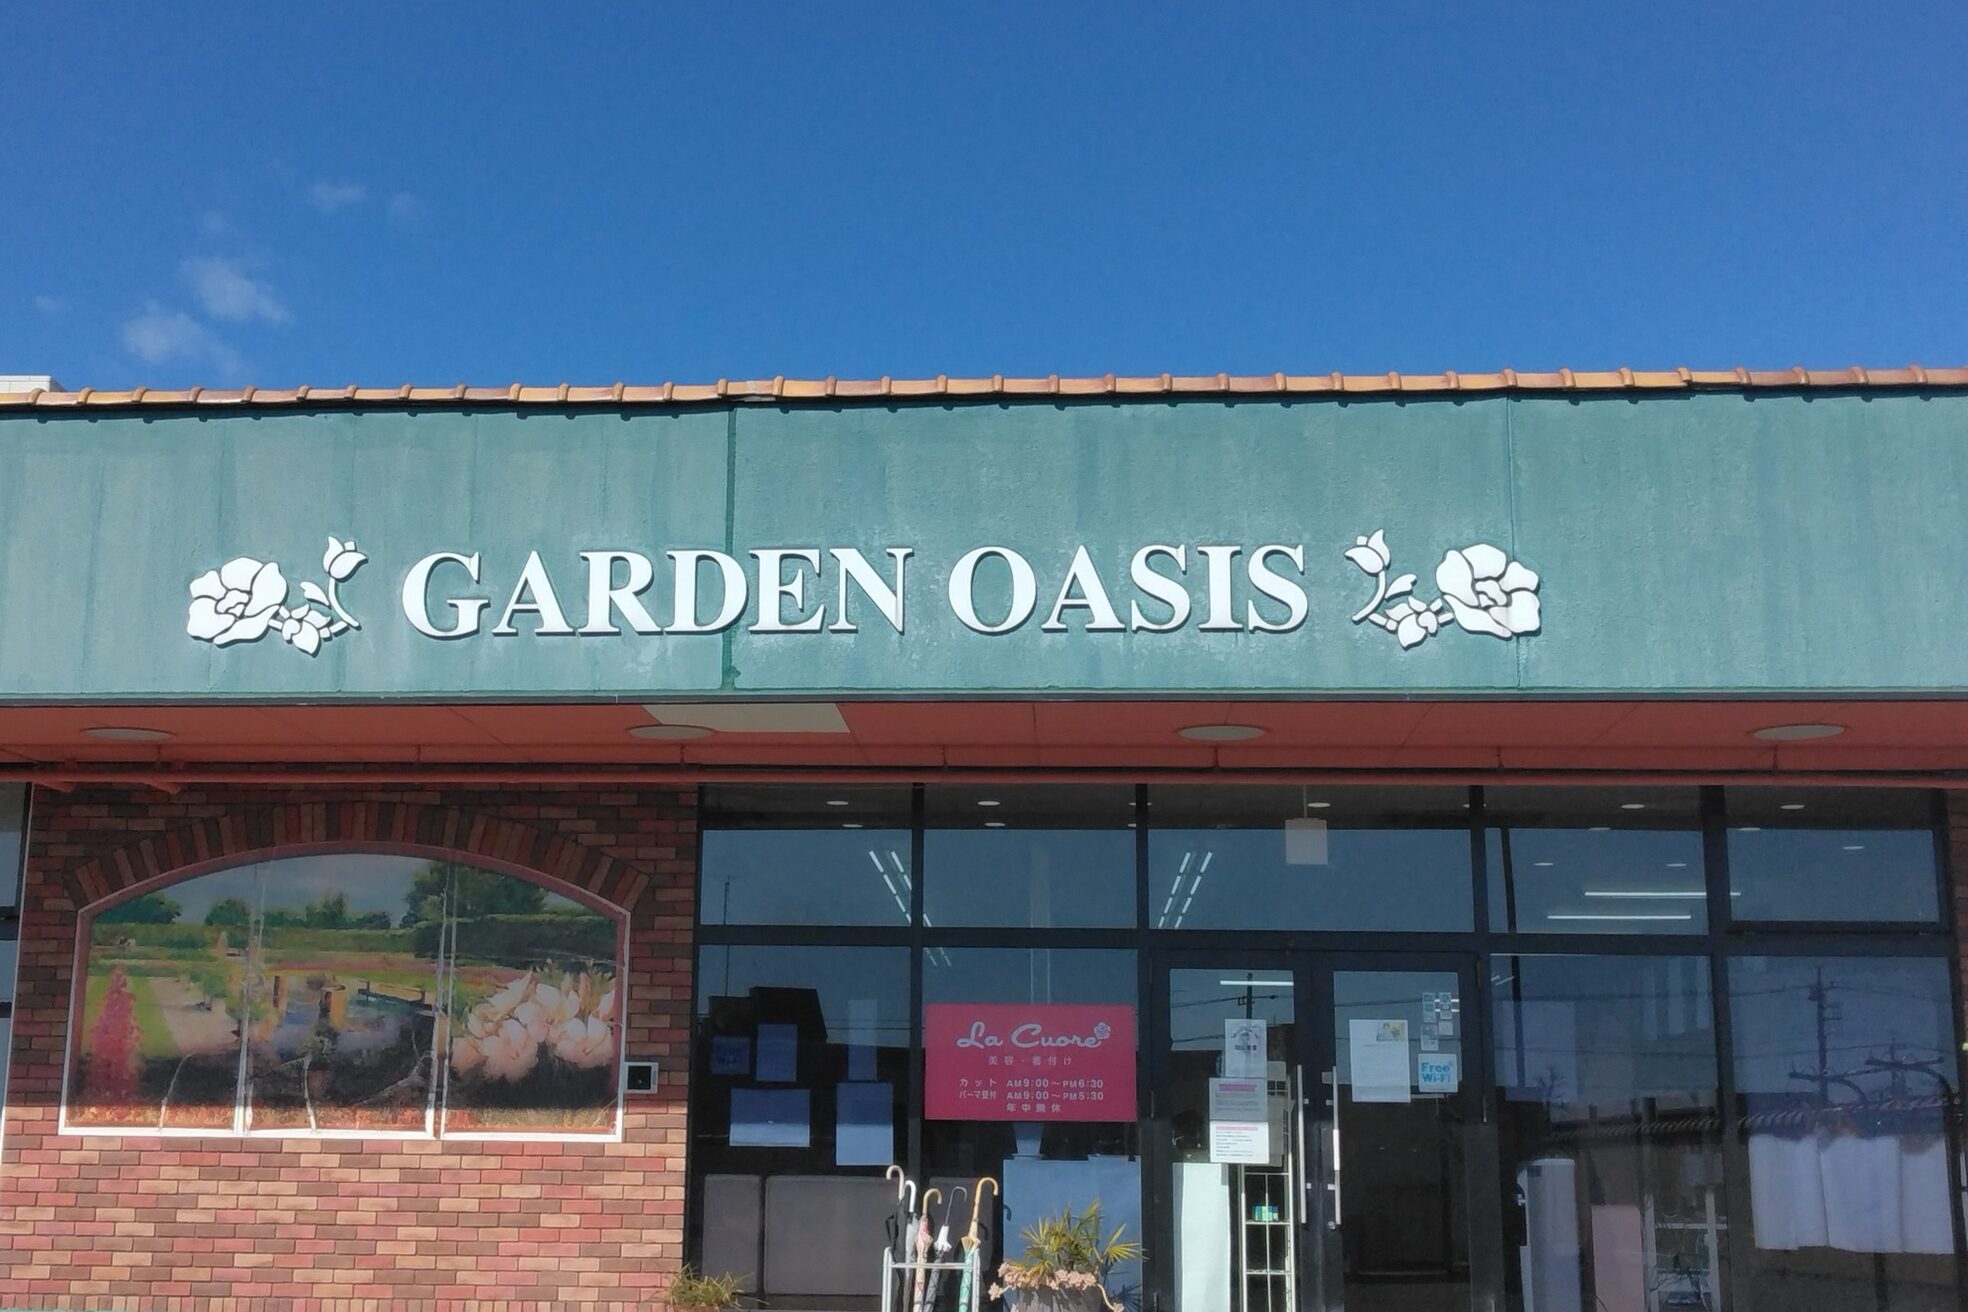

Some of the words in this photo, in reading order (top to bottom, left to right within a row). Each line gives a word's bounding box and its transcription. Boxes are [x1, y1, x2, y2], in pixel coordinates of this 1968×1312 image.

[401, 546, 915, 640] GARDEN
[948, 544, 1309, 636] OASIS
[956, 1021, 1004, 1049] La
[1011, 1022, 1103, 1049] Cuore
[1421, 1062, 1452, 1074] Free
[959, 1078, 998, 1088] カット
[1006, 1103, 1062, 1114] 年中無休
